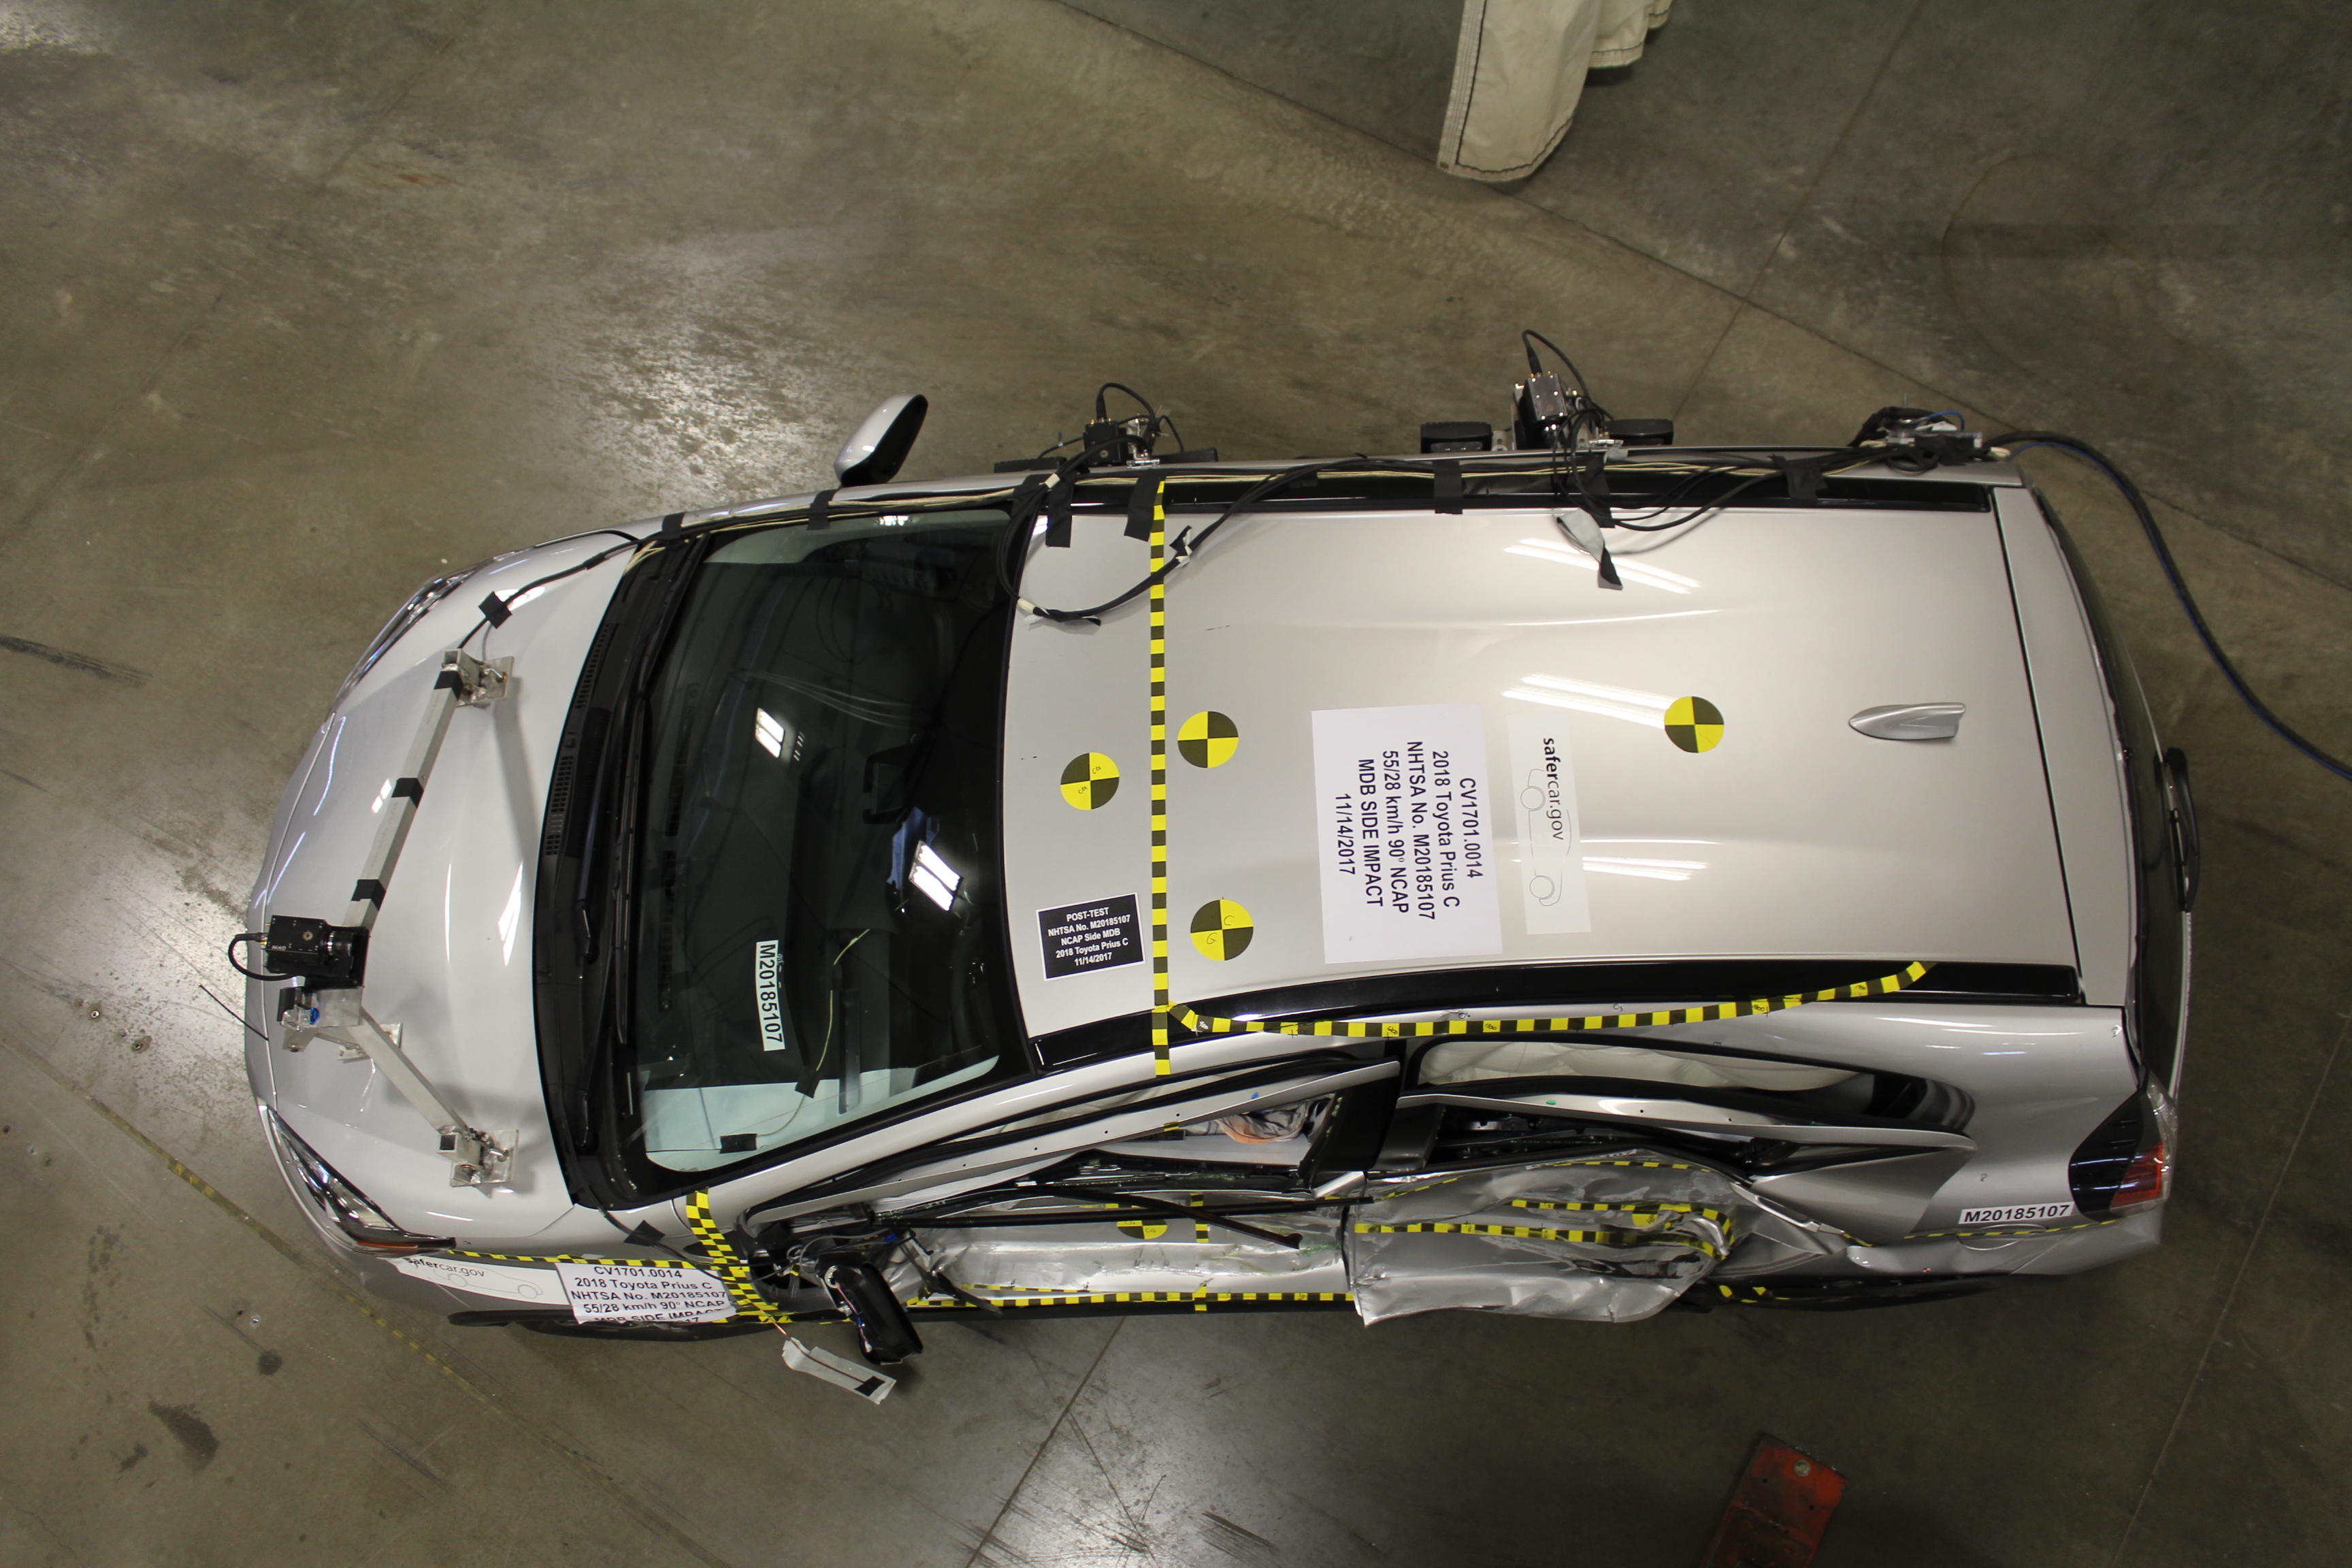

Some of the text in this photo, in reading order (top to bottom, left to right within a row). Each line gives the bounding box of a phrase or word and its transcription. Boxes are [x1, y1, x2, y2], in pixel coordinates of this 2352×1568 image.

[1383, 751, 1401, 791] 55/28
[1544, 737, 1563, 840] safercar.gov
[1386, 796, 1403, 834] km/h
[1407, 741, 1435, 919] NHTSA No. M20185107
[1432, 751, 1460, 907] 2018 Toyota Prius C
[1459, 778, 1483, 878] CV1701.0014
[1335, 794, 1356, 875] 11/14/2017
[1358, 759, 1384, 907] MDB SIDE IMPACT
[1390, 867, 1409, 913] NCAP
[1047, 914, 1131, 936] NHTSA No. M20185107
[1066, 906, 1109, 922] POST-TEST
[1056, 949, 1074, 958] 2018
[1074, 944, 1100, 955] Toyota
[1100, 940, 1121, 950] Prius
[1061, 928, 1121, 946] NCAP Side MDB
[1074, 952, 1113, 966] 11/14/2017
[759, 944, 783, 1043] M20185107
[1964, 1205, 2070, 1222] M20185107
[574, 1277, 713, 1290] 2018 Toyota Prius C
[593, 1266, 683, 1278] CV1701.0014
[570, 1290, 621, 1301] NHTSA
[651, 1291, 726, 1299] M20185107
[583, 1303, 619, 1313] 55/28
[622, 1301, 657, 1311] km/h
[685, 1300, 725, 1308] NCAP
